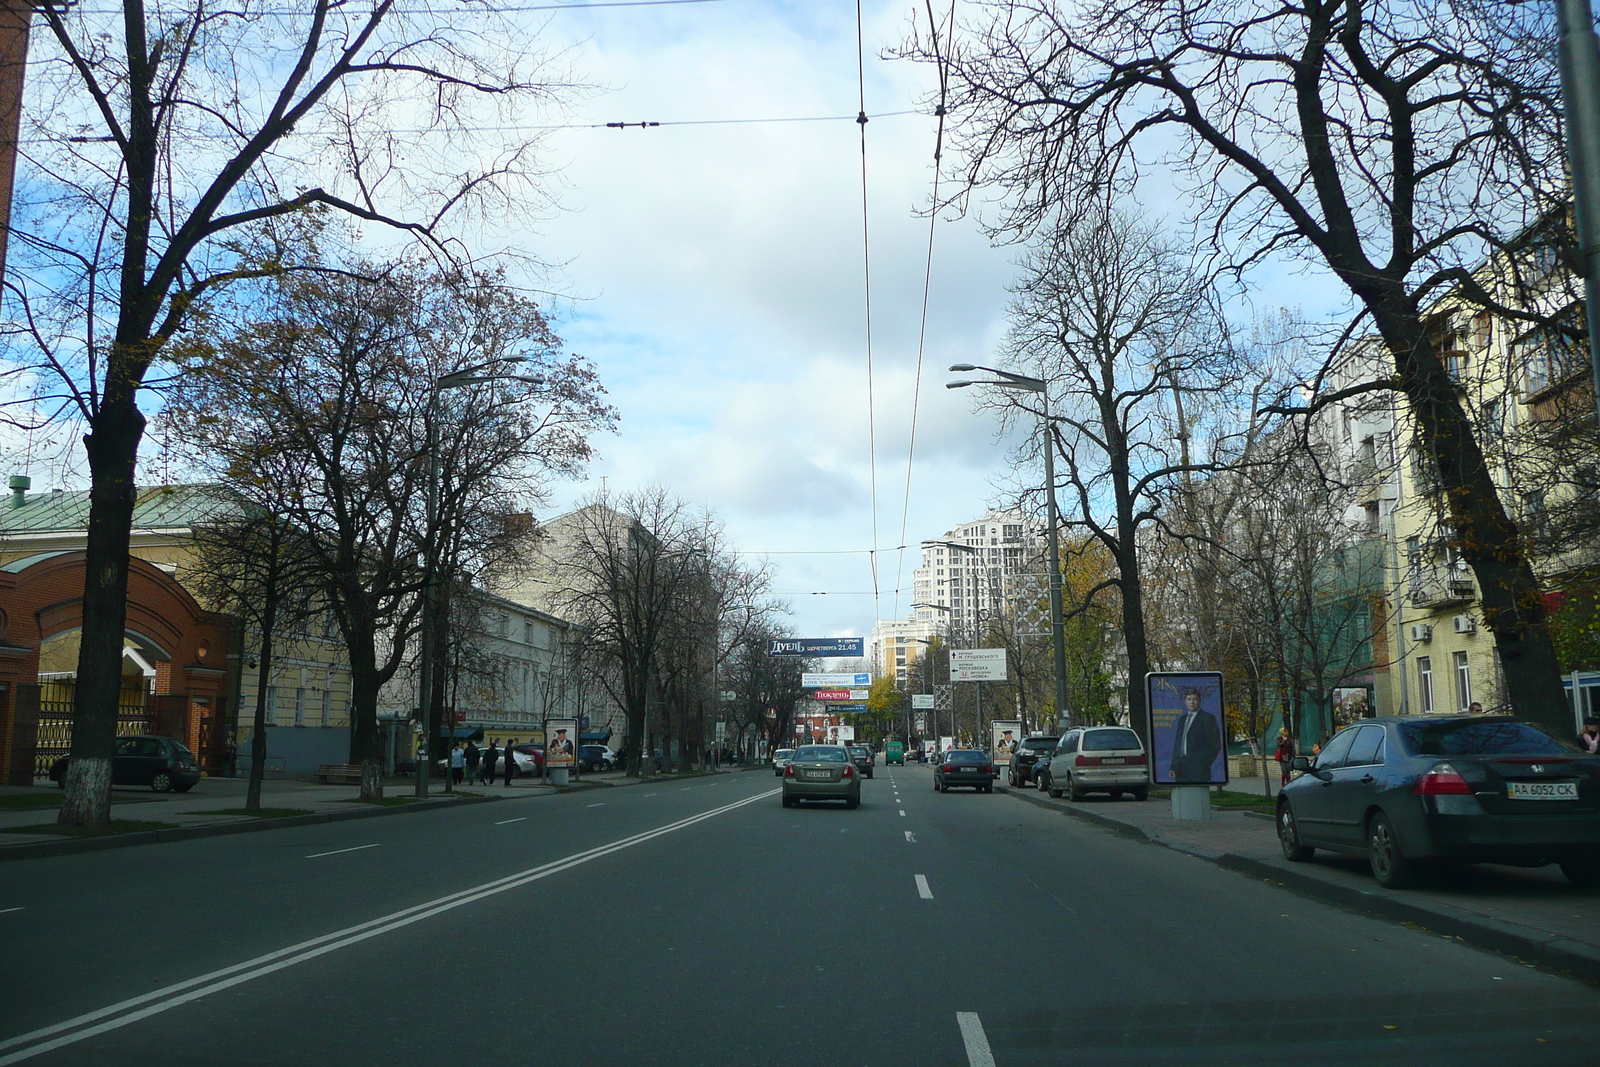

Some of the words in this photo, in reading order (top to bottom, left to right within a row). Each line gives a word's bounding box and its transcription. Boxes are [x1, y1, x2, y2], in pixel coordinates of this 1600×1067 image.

[1514, 784, 1529, 794] AA
[1530, 785, 1555, 795] 6052
[1556, 784, 1574, 795] CK
